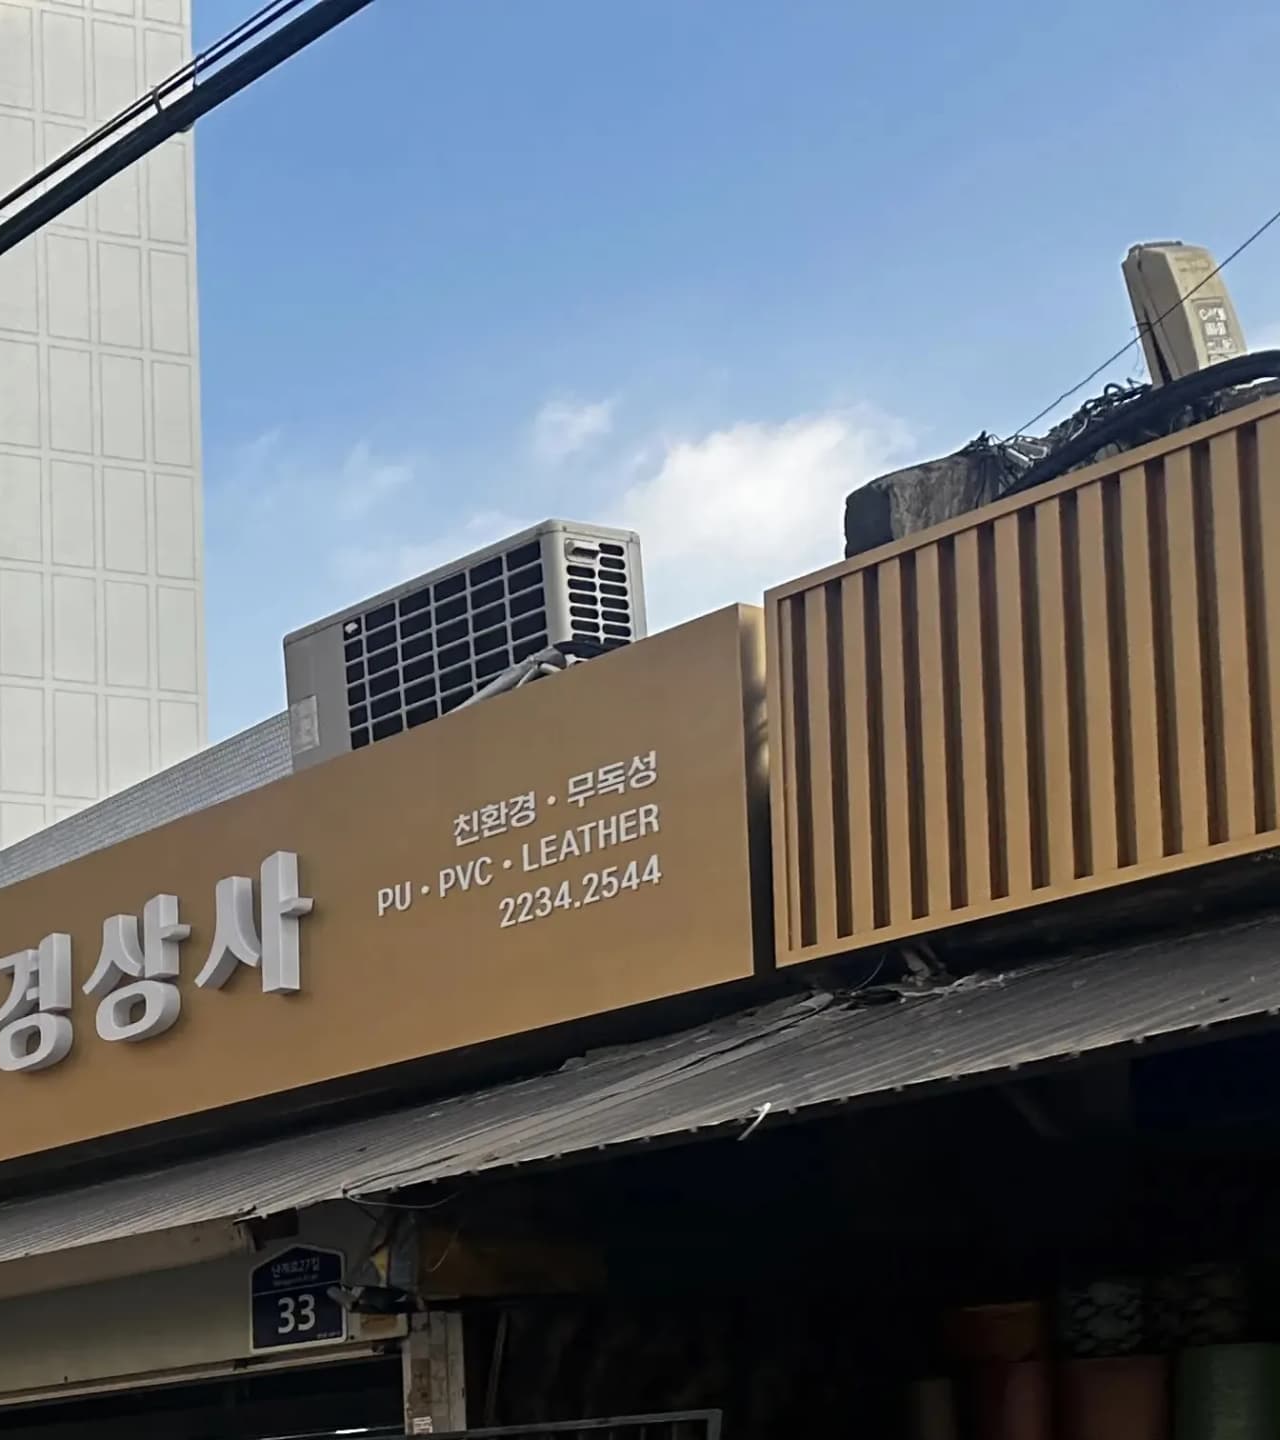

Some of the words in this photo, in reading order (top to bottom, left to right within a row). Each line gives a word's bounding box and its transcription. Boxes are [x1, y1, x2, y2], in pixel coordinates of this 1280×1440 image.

[453, 790, 536, 847] 친환경
[566, 749, 658, 808] 무독성
[377, 881, 413, 918] PU
[439, 855, 494, 899] PVC
[521, 803, 660, 873] LEATHER
[498, 853, 663, 929] 2234.2544
[277, 1293, 316, 1335] 33
